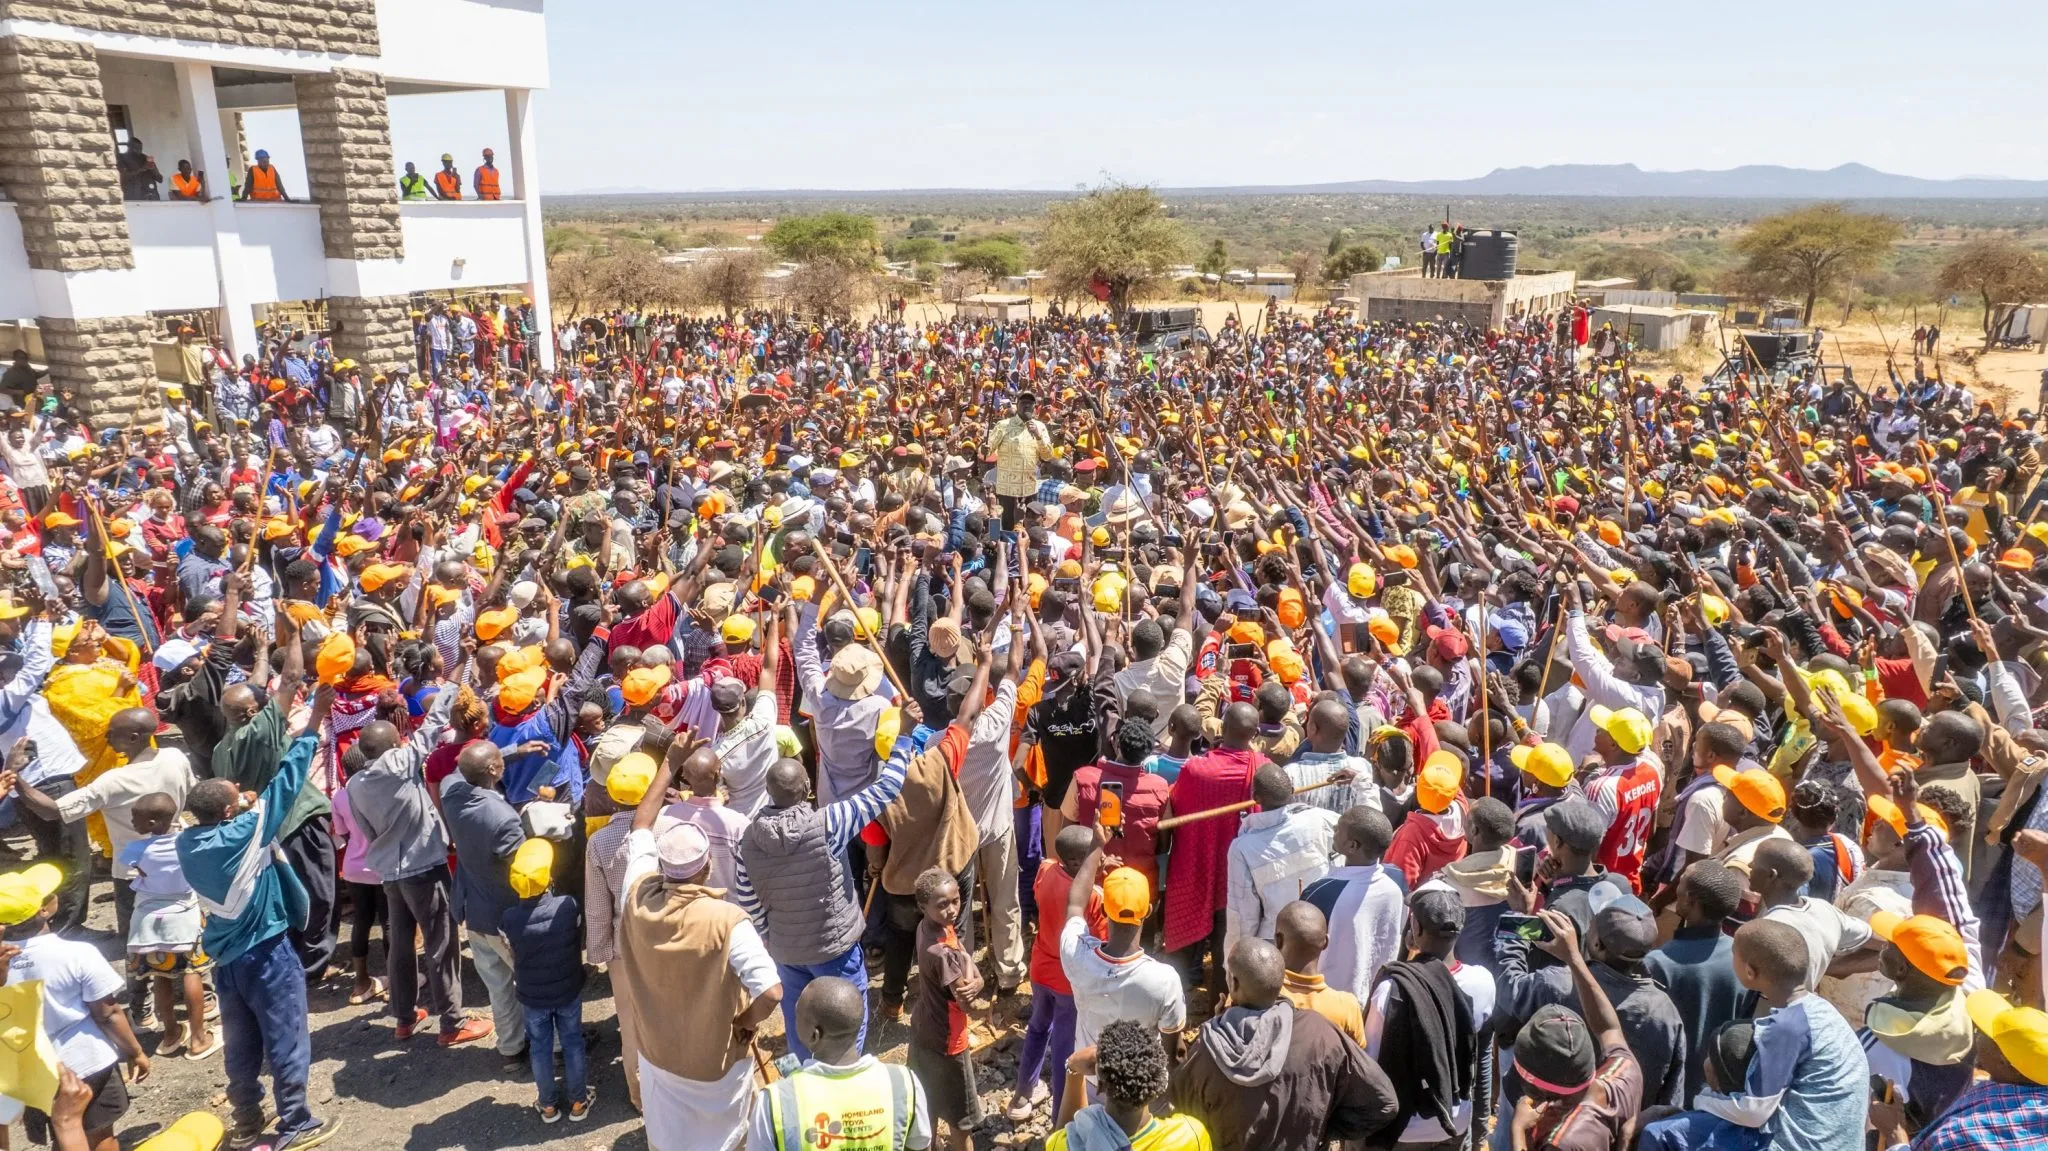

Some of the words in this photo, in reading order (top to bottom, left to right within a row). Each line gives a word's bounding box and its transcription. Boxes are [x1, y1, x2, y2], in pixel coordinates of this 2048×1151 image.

[1617, 807, 1652, 857] 32
[841, 1107, 885, 1119] HOMELAND
[843, 1125, 873, 1134] EVENTS
